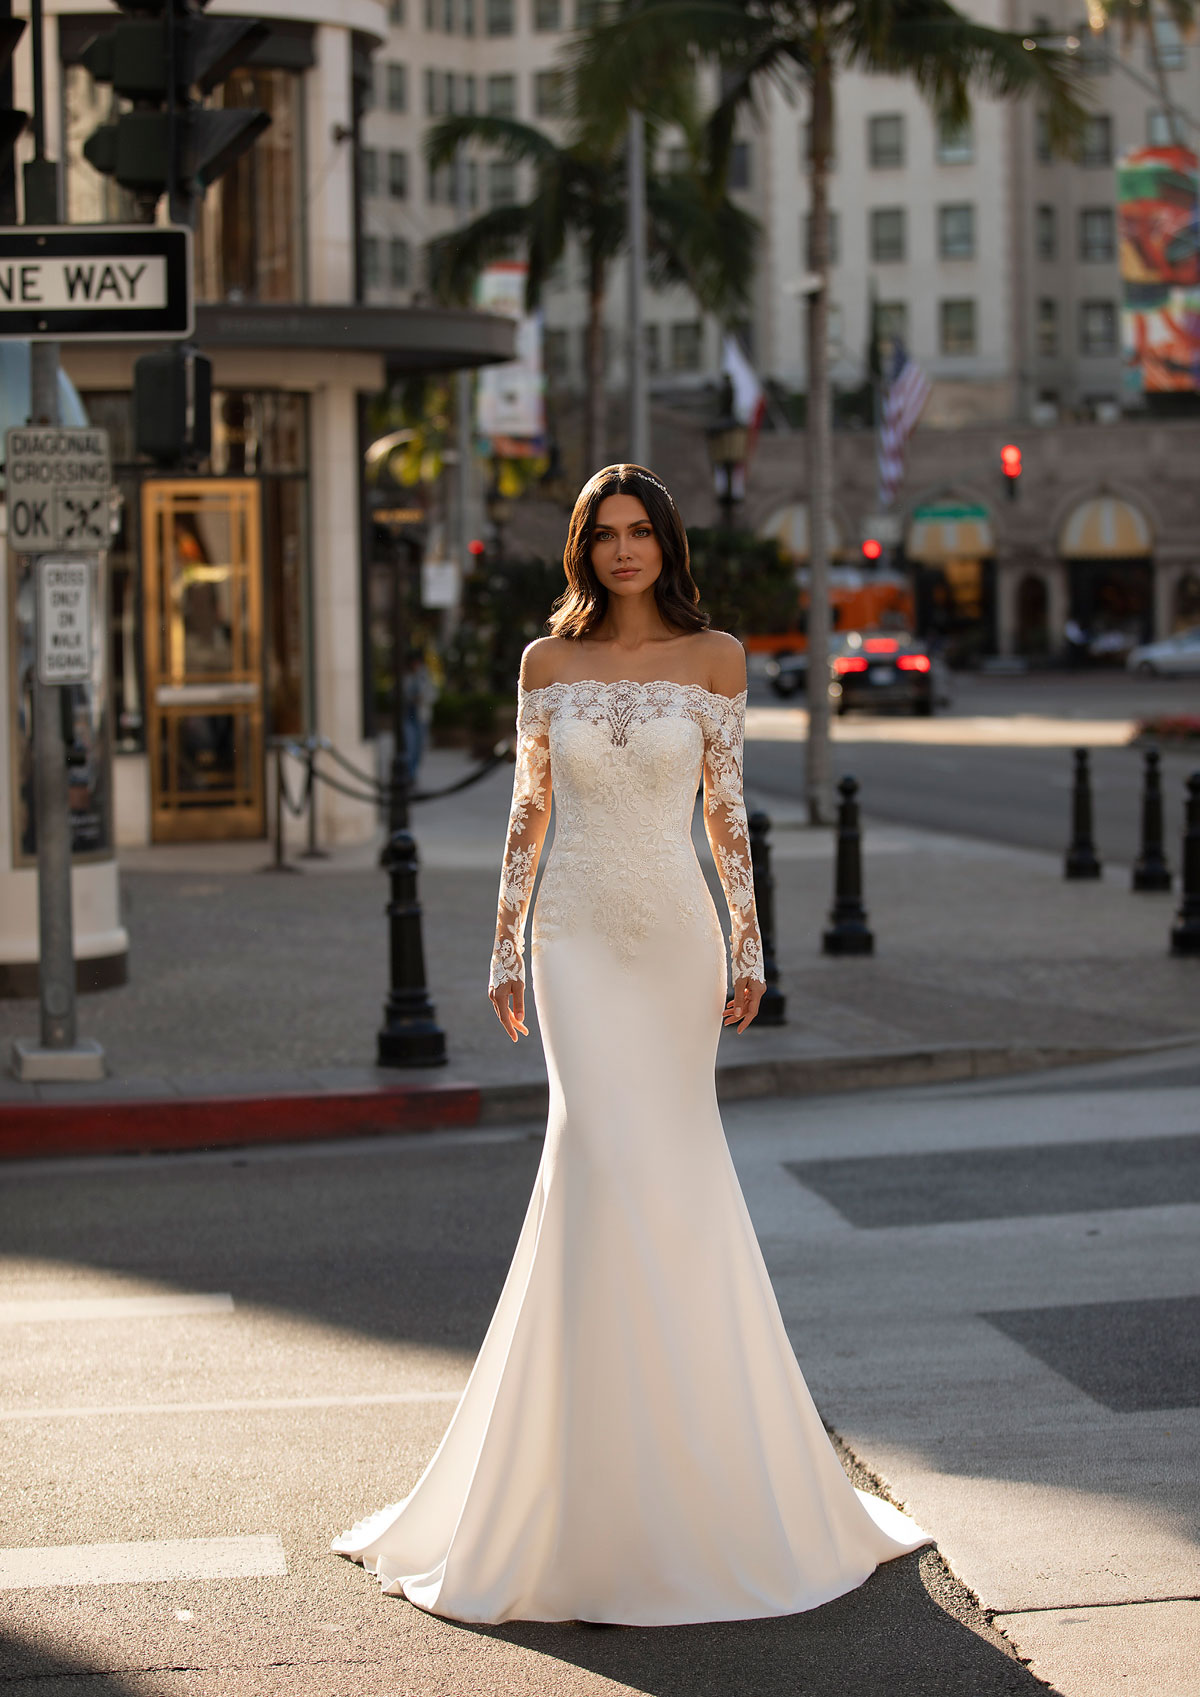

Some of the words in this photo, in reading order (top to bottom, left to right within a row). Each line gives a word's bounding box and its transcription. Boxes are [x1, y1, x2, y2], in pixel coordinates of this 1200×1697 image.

[64, 263, 147, 301] WAY
[11, 433, 104, 456] DIAGONAL
[12, 461, 107, 484] CROSSING
[13, 501, 49, 537] OK
